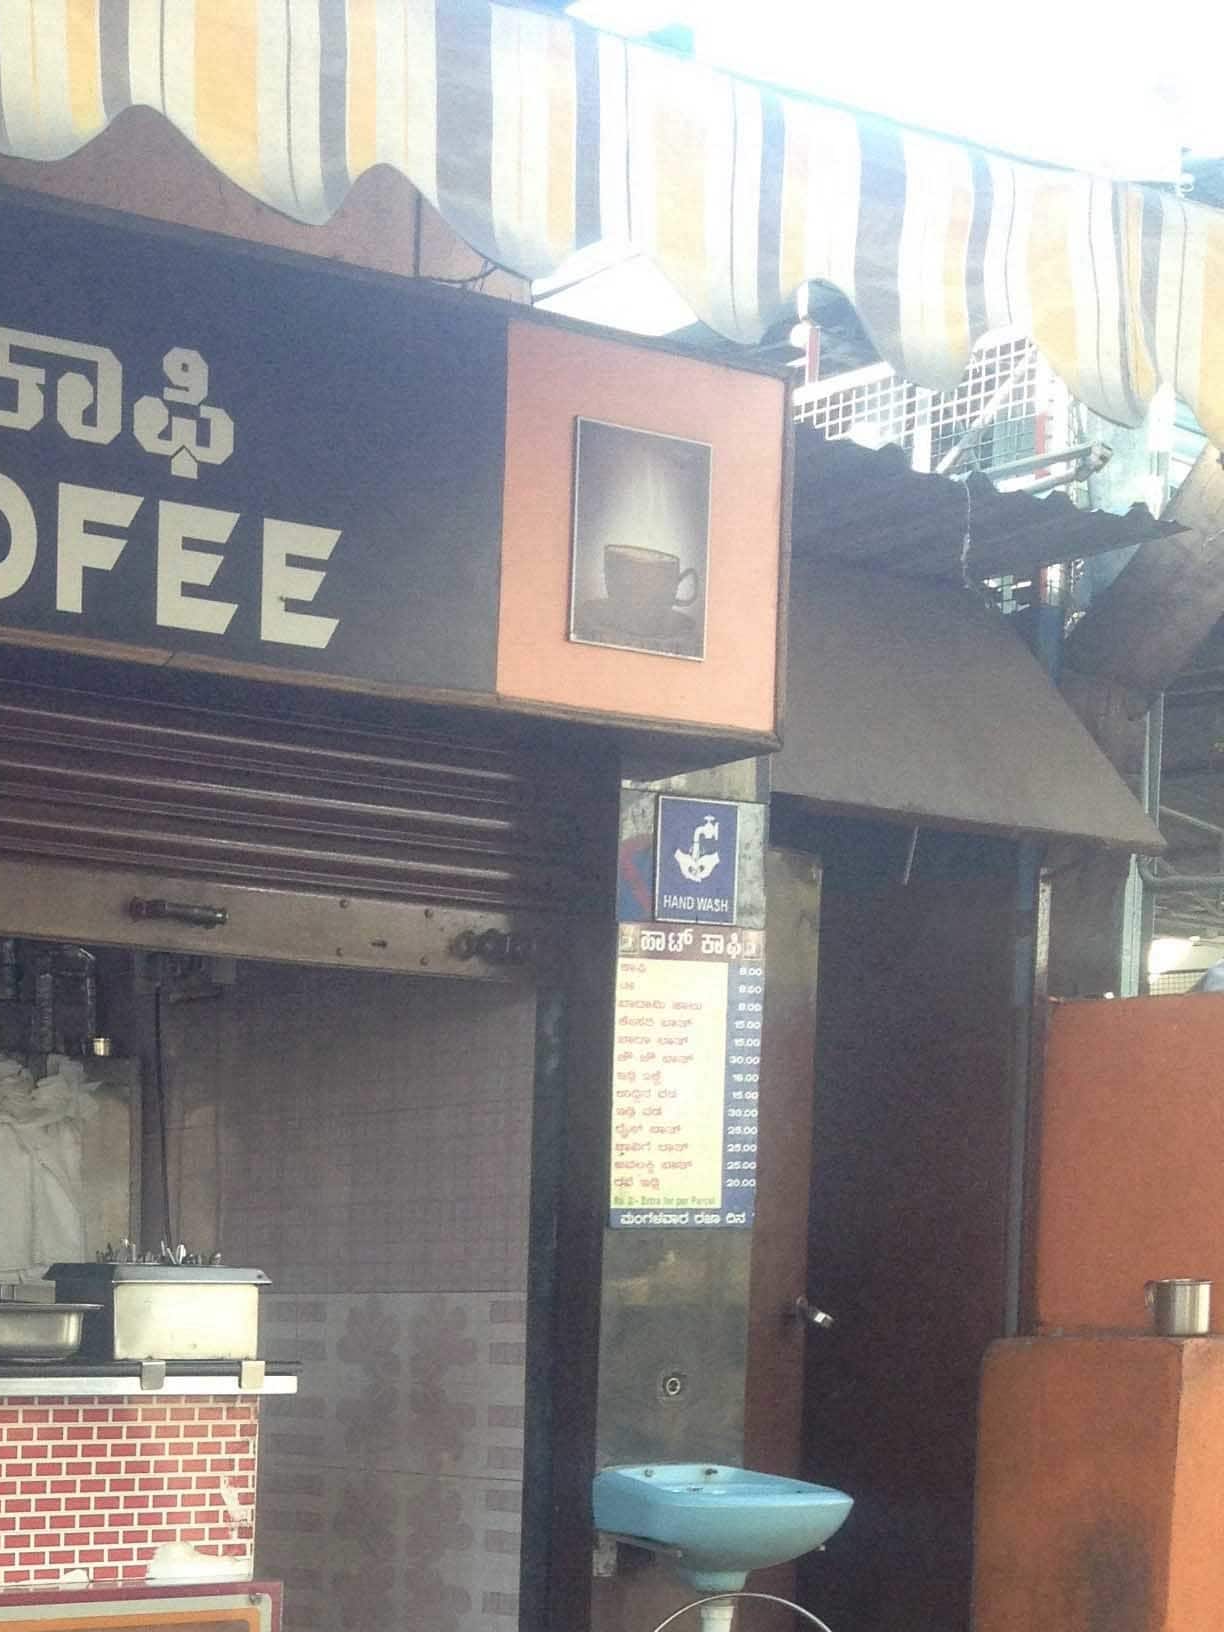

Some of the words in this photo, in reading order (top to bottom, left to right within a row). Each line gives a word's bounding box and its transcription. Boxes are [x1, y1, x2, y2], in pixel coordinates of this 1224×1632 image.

[663, 894, 694, 911] HAND
[696, 896, 729, 913] WASH
[727, 1126, 758, 1136] 25.00
[727, 1143, 757, 1154] 25.00
[726, 1161, 757, 1172] 25.00
[726, 1178, 756, 1190] 20.00
